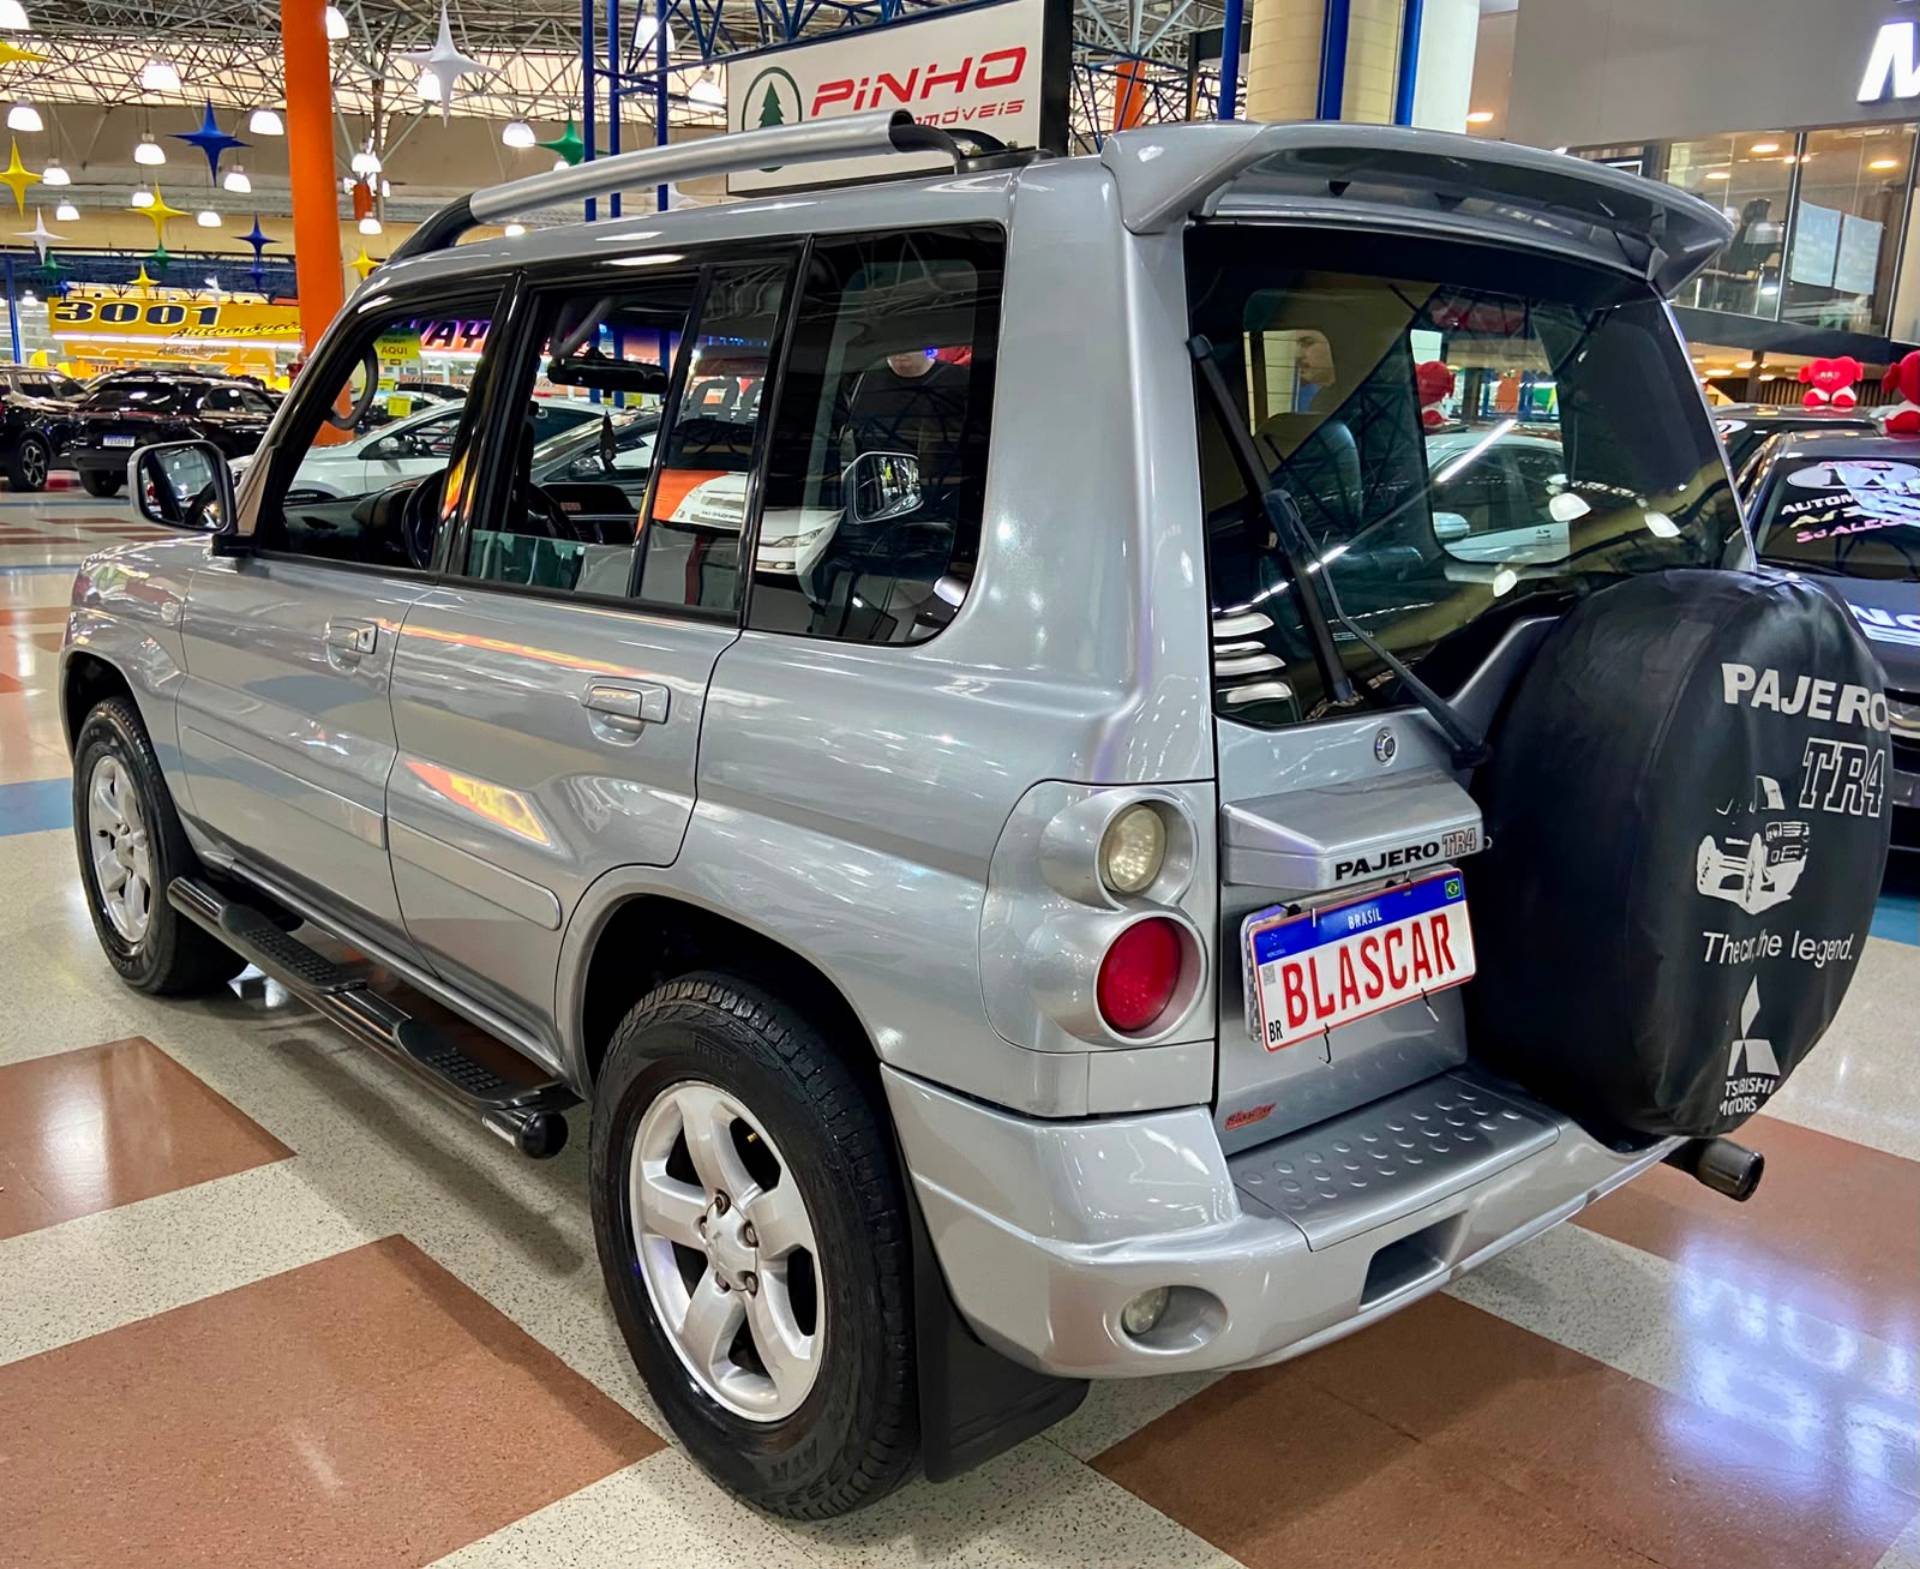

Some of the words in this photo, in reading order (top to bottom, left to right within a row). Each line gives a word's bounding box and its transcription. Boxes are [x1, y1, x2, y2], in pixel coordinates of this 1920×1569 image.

[54, 300, 221, 326] 3001
[1720, 663, 1889, 732] PAJERO
[1799, 737, 1885, 818] TR4
[1335, 842, 1440, 880] PAJERO
[1442, 828, 1478, 858] TR4
[1347, 907, 1383, 930] BRASIL
[1282, 913, 1456, 1029] BLASCAR
[1791, 930, 1854, 969] legend.
[1268, 1019, 1284, 1042] BR
